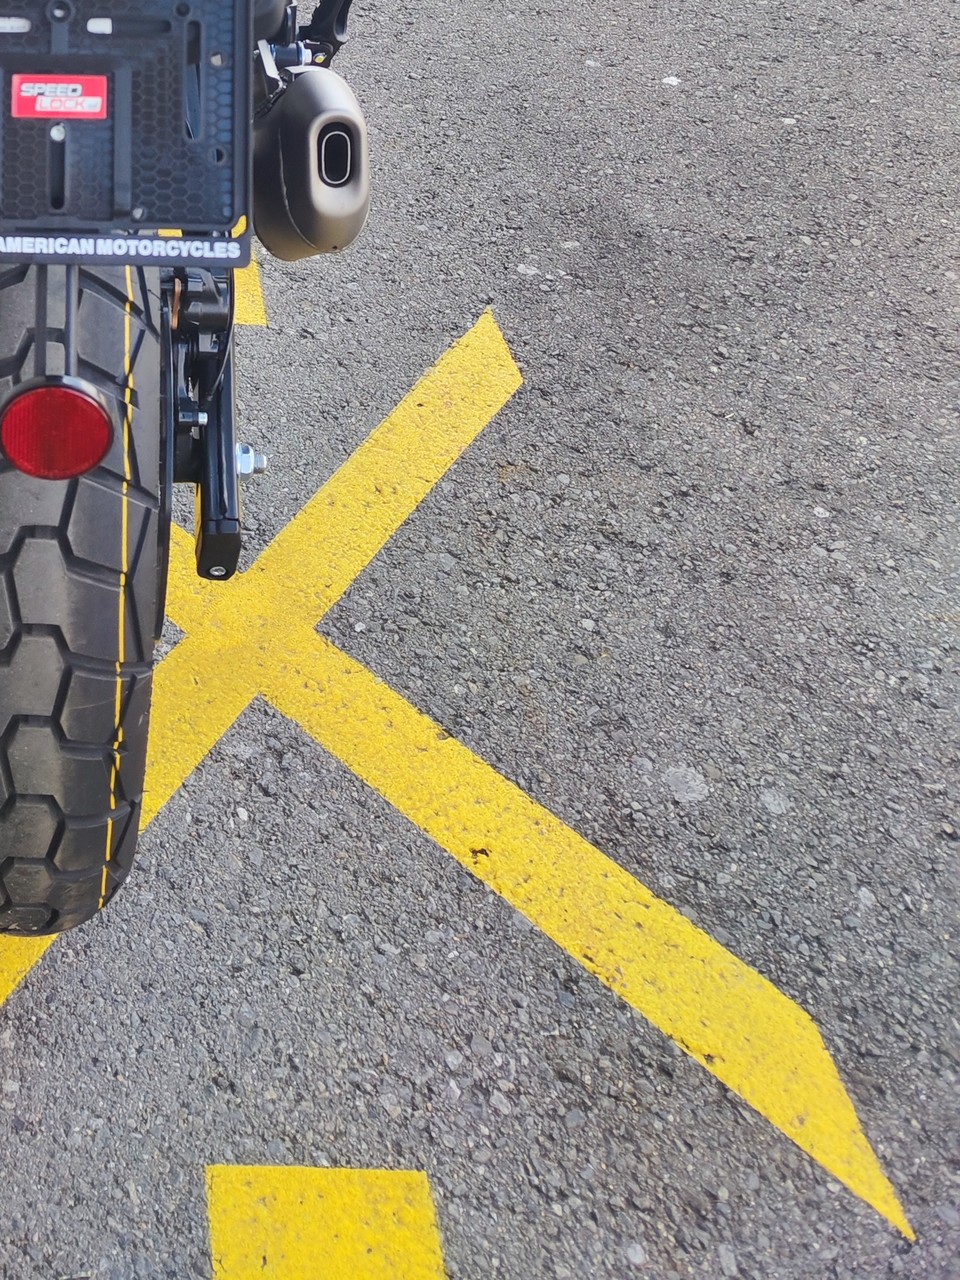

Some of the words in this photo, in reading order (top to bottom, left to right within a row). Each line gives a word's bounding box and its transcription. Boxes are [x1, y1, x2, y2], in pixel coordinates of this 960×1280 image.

[20, 83, 82, 97] SPEED
[39, 98, 85, 110] LOCK
[96, 238, 241, 259] MOTORCYCLES
